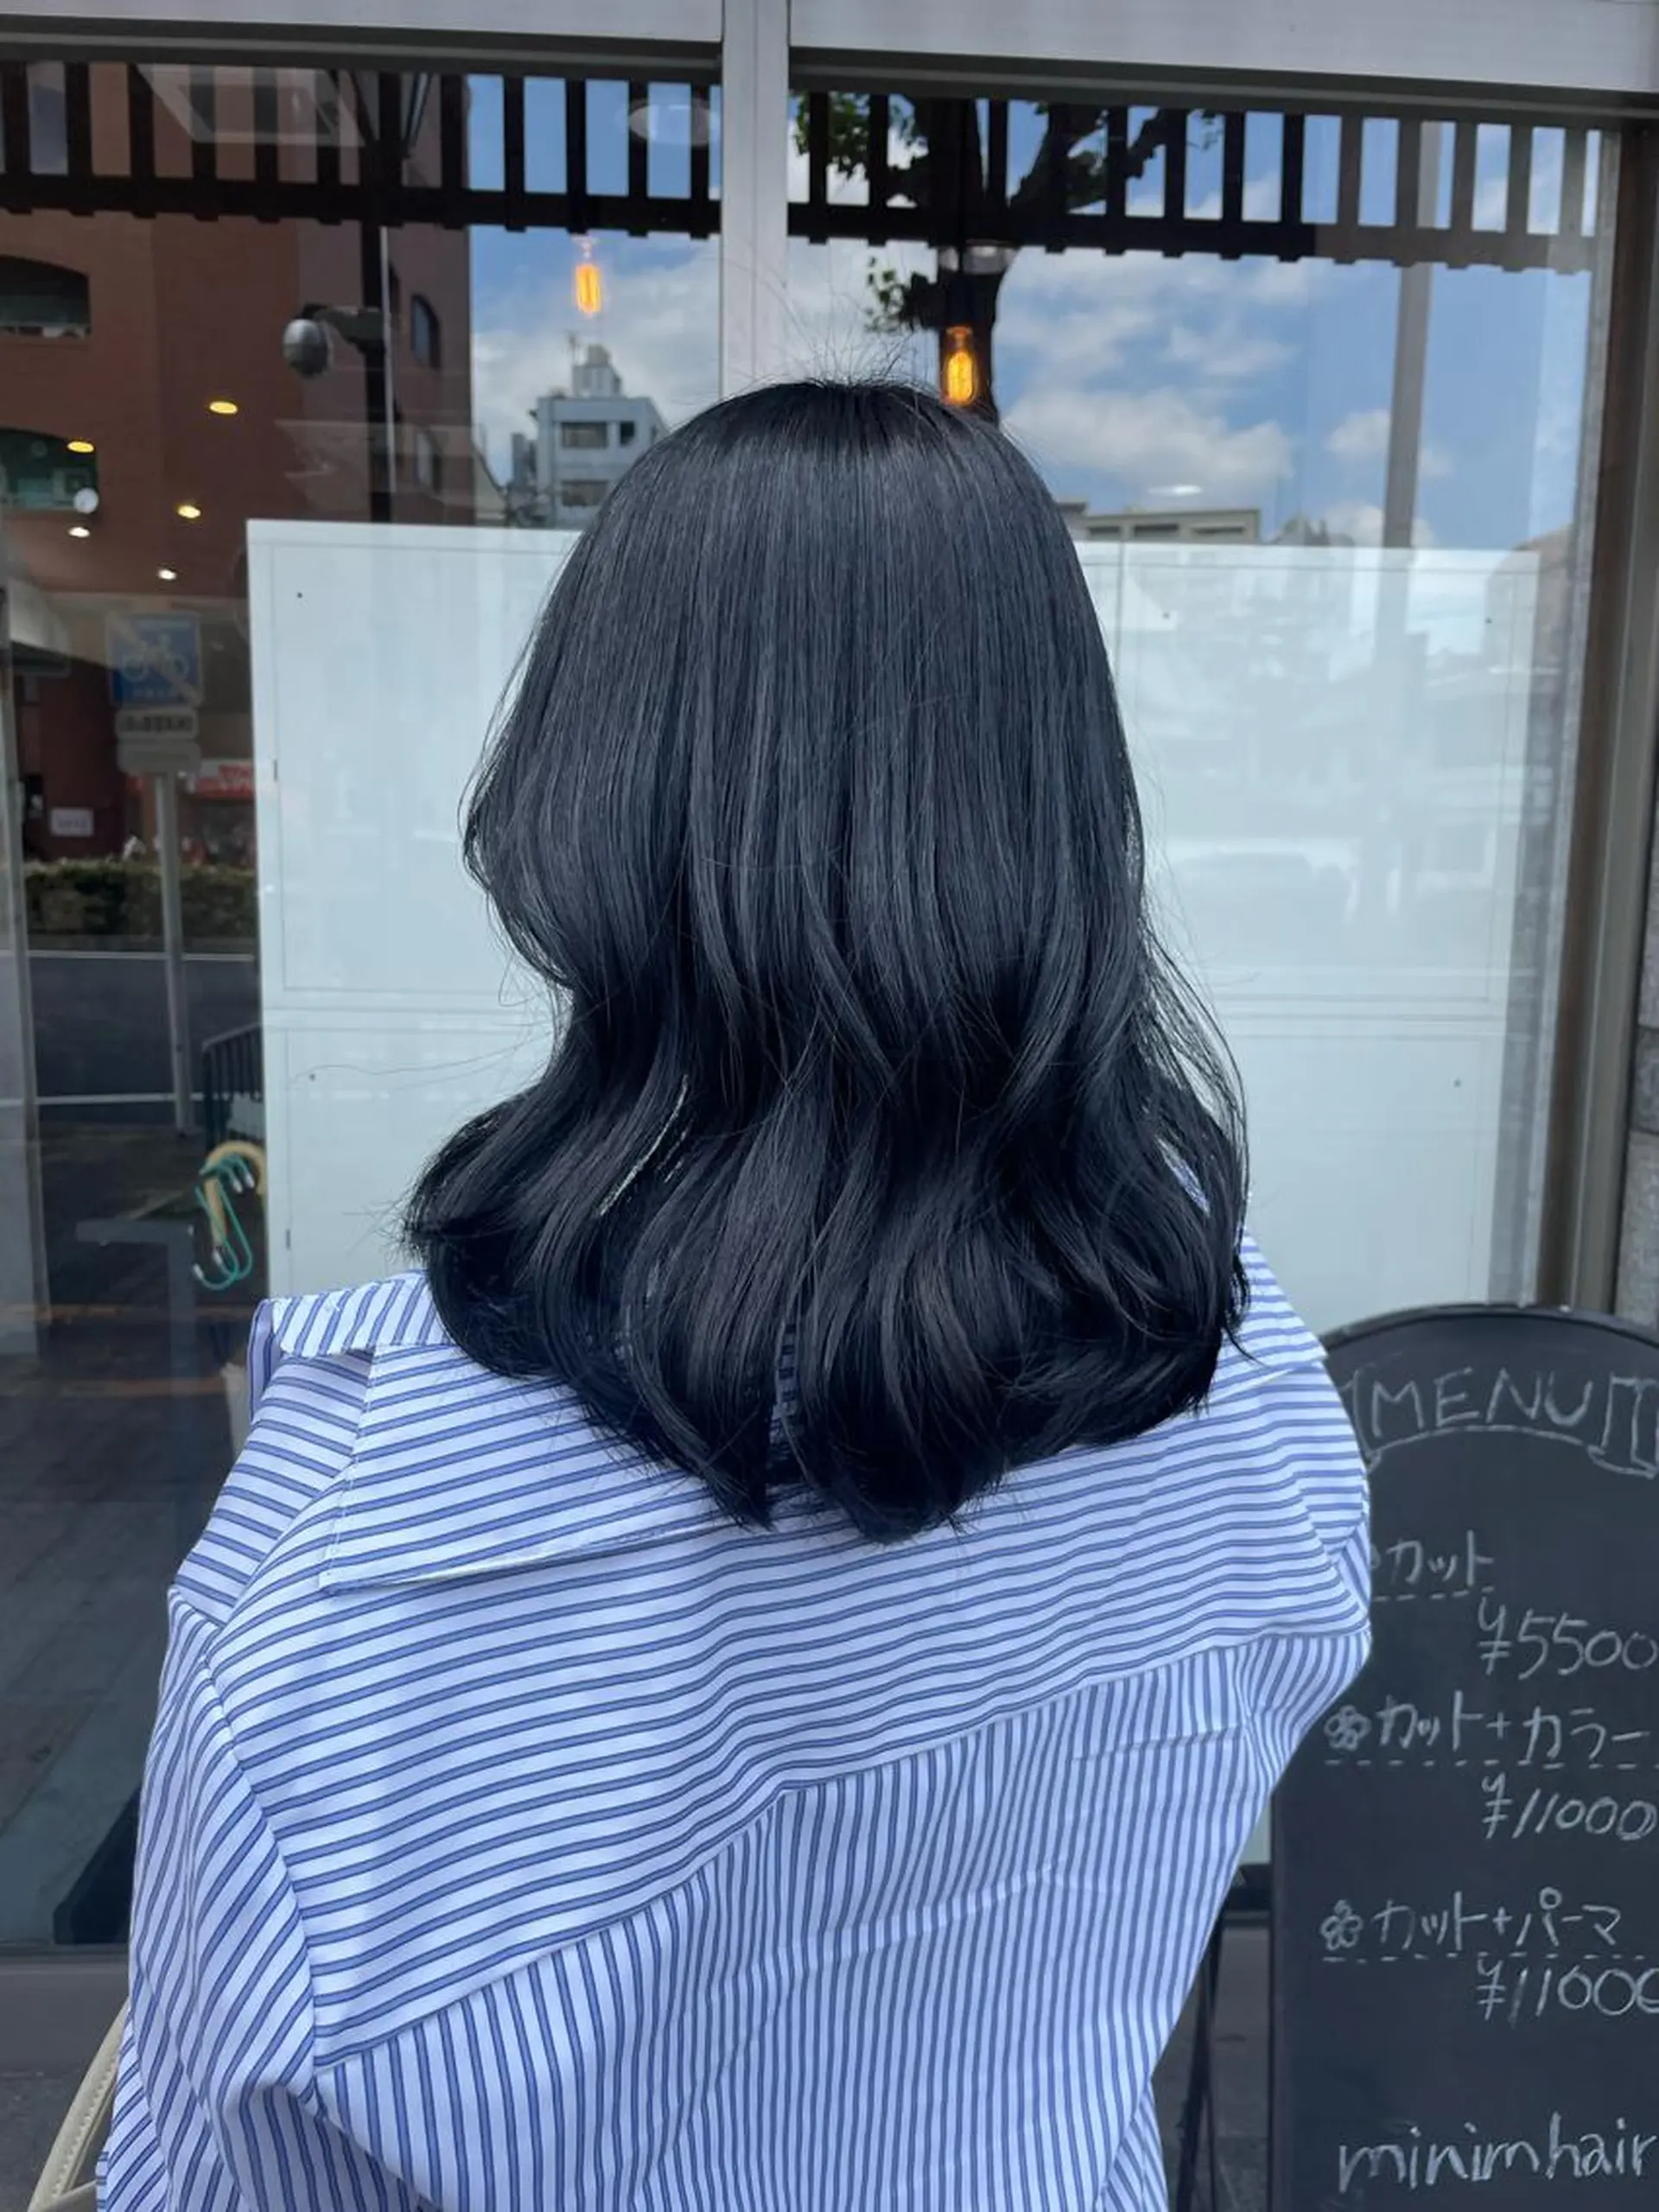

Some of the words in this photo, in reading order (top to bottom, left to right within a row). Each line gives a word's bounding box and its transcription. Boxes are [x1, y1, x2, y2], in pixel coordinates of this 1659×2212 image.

[1370, 1362, 1594, 1438] MENU
[1387, 1530, 1493, 1586] カット
[1478, 1596, 1658, 1680] ¥5500
[1481, 1772, 1657, 1840] ¥11000
